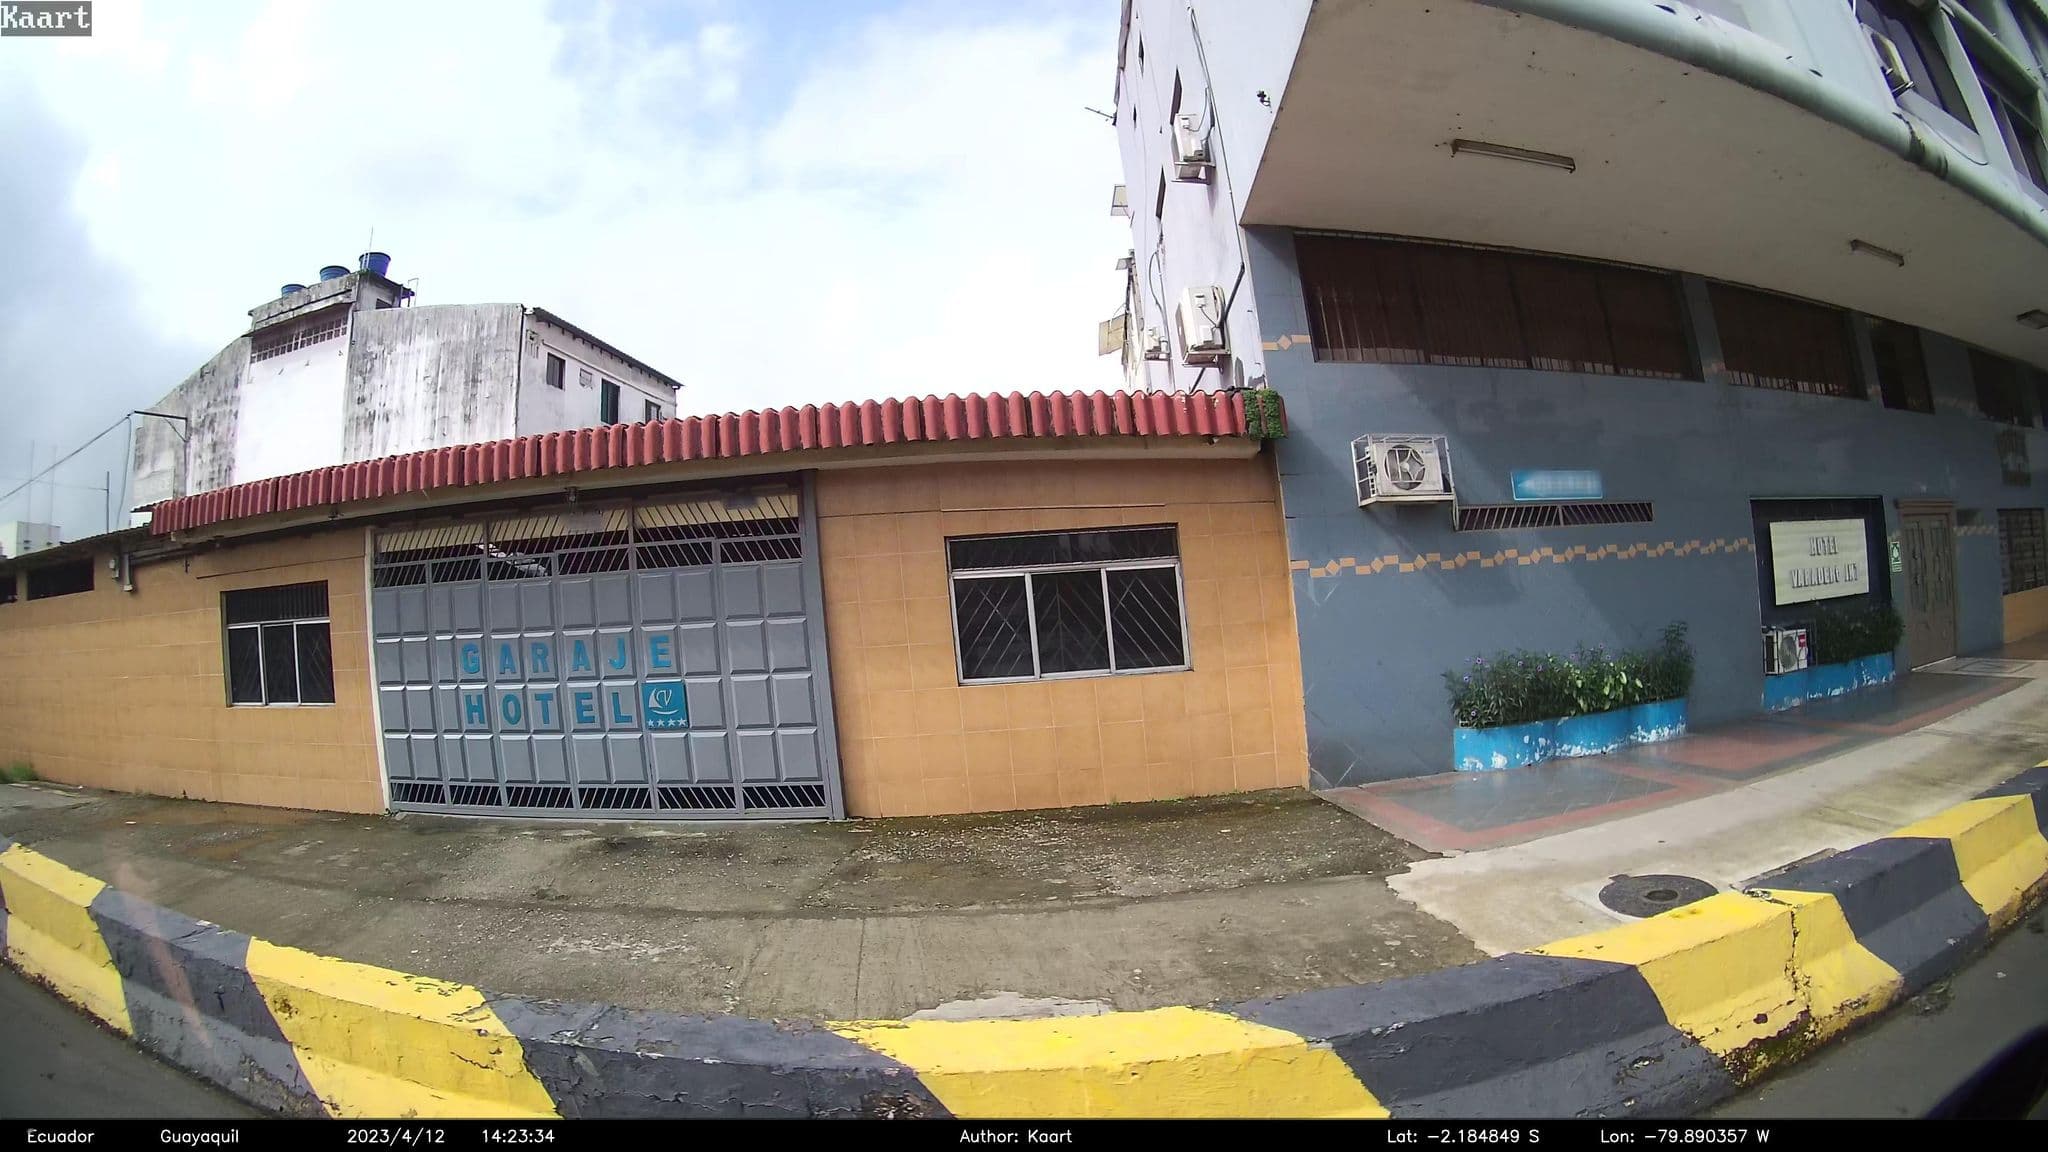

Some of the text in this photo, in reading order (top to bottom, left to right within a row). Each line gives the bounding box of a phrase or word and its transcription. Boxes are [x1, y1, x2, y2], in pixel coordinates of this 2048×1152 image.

[1809, 536, 1839, 557] HOTEL
[460, 635, 672, 674] GARAJE
[465, 691, 633, 725] HOTEL
